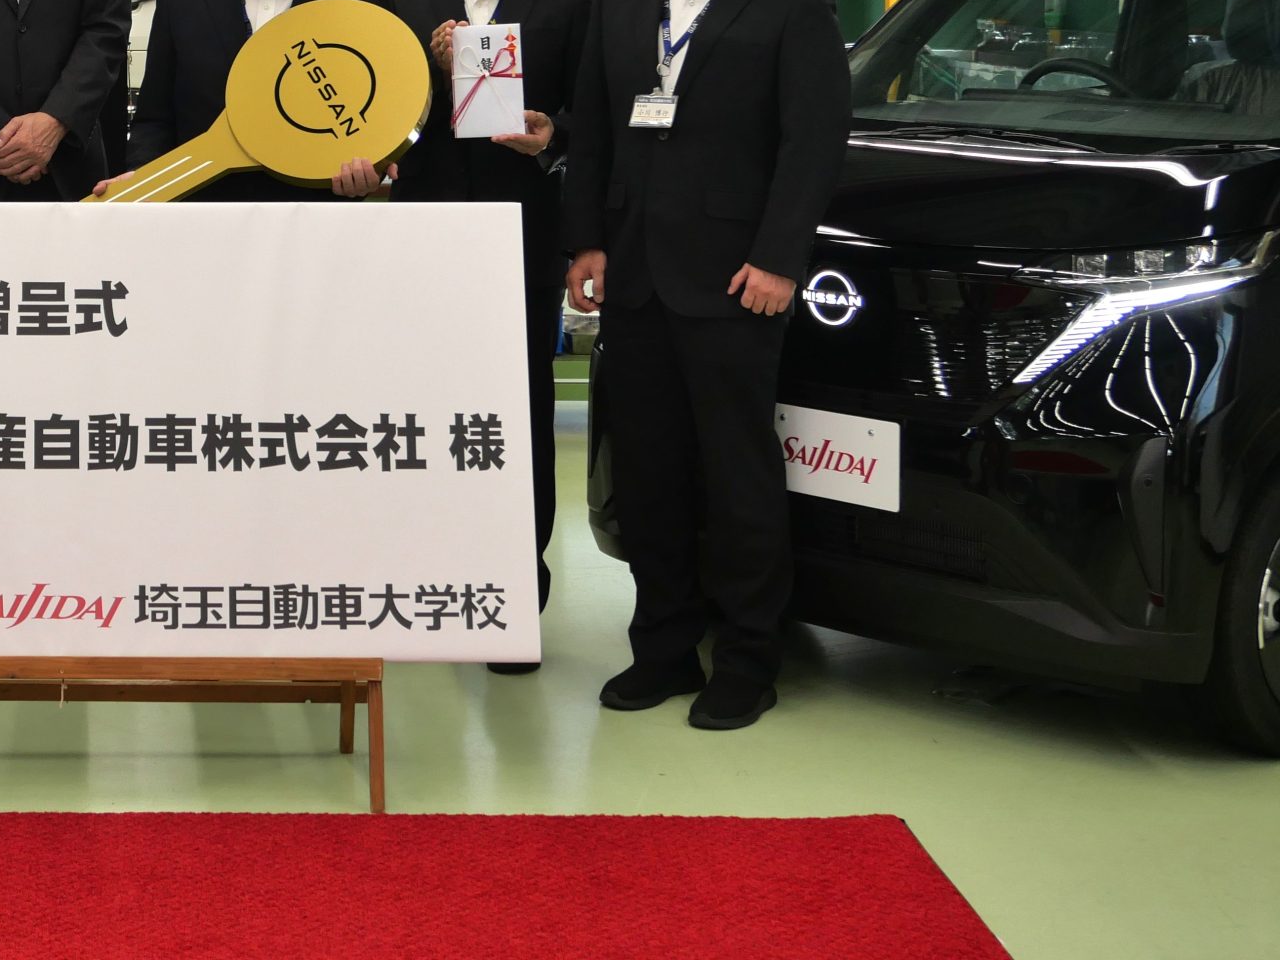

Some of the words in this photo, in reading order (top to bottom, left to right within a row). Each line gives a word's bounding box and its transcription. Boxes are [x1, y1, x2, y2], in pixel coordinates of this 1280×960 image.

[291, 40, 360, 137] NISSAN
[802, 289, 862, 307] NISSAN
[133, 583, 508, 632] 埼玉自動車大学校
